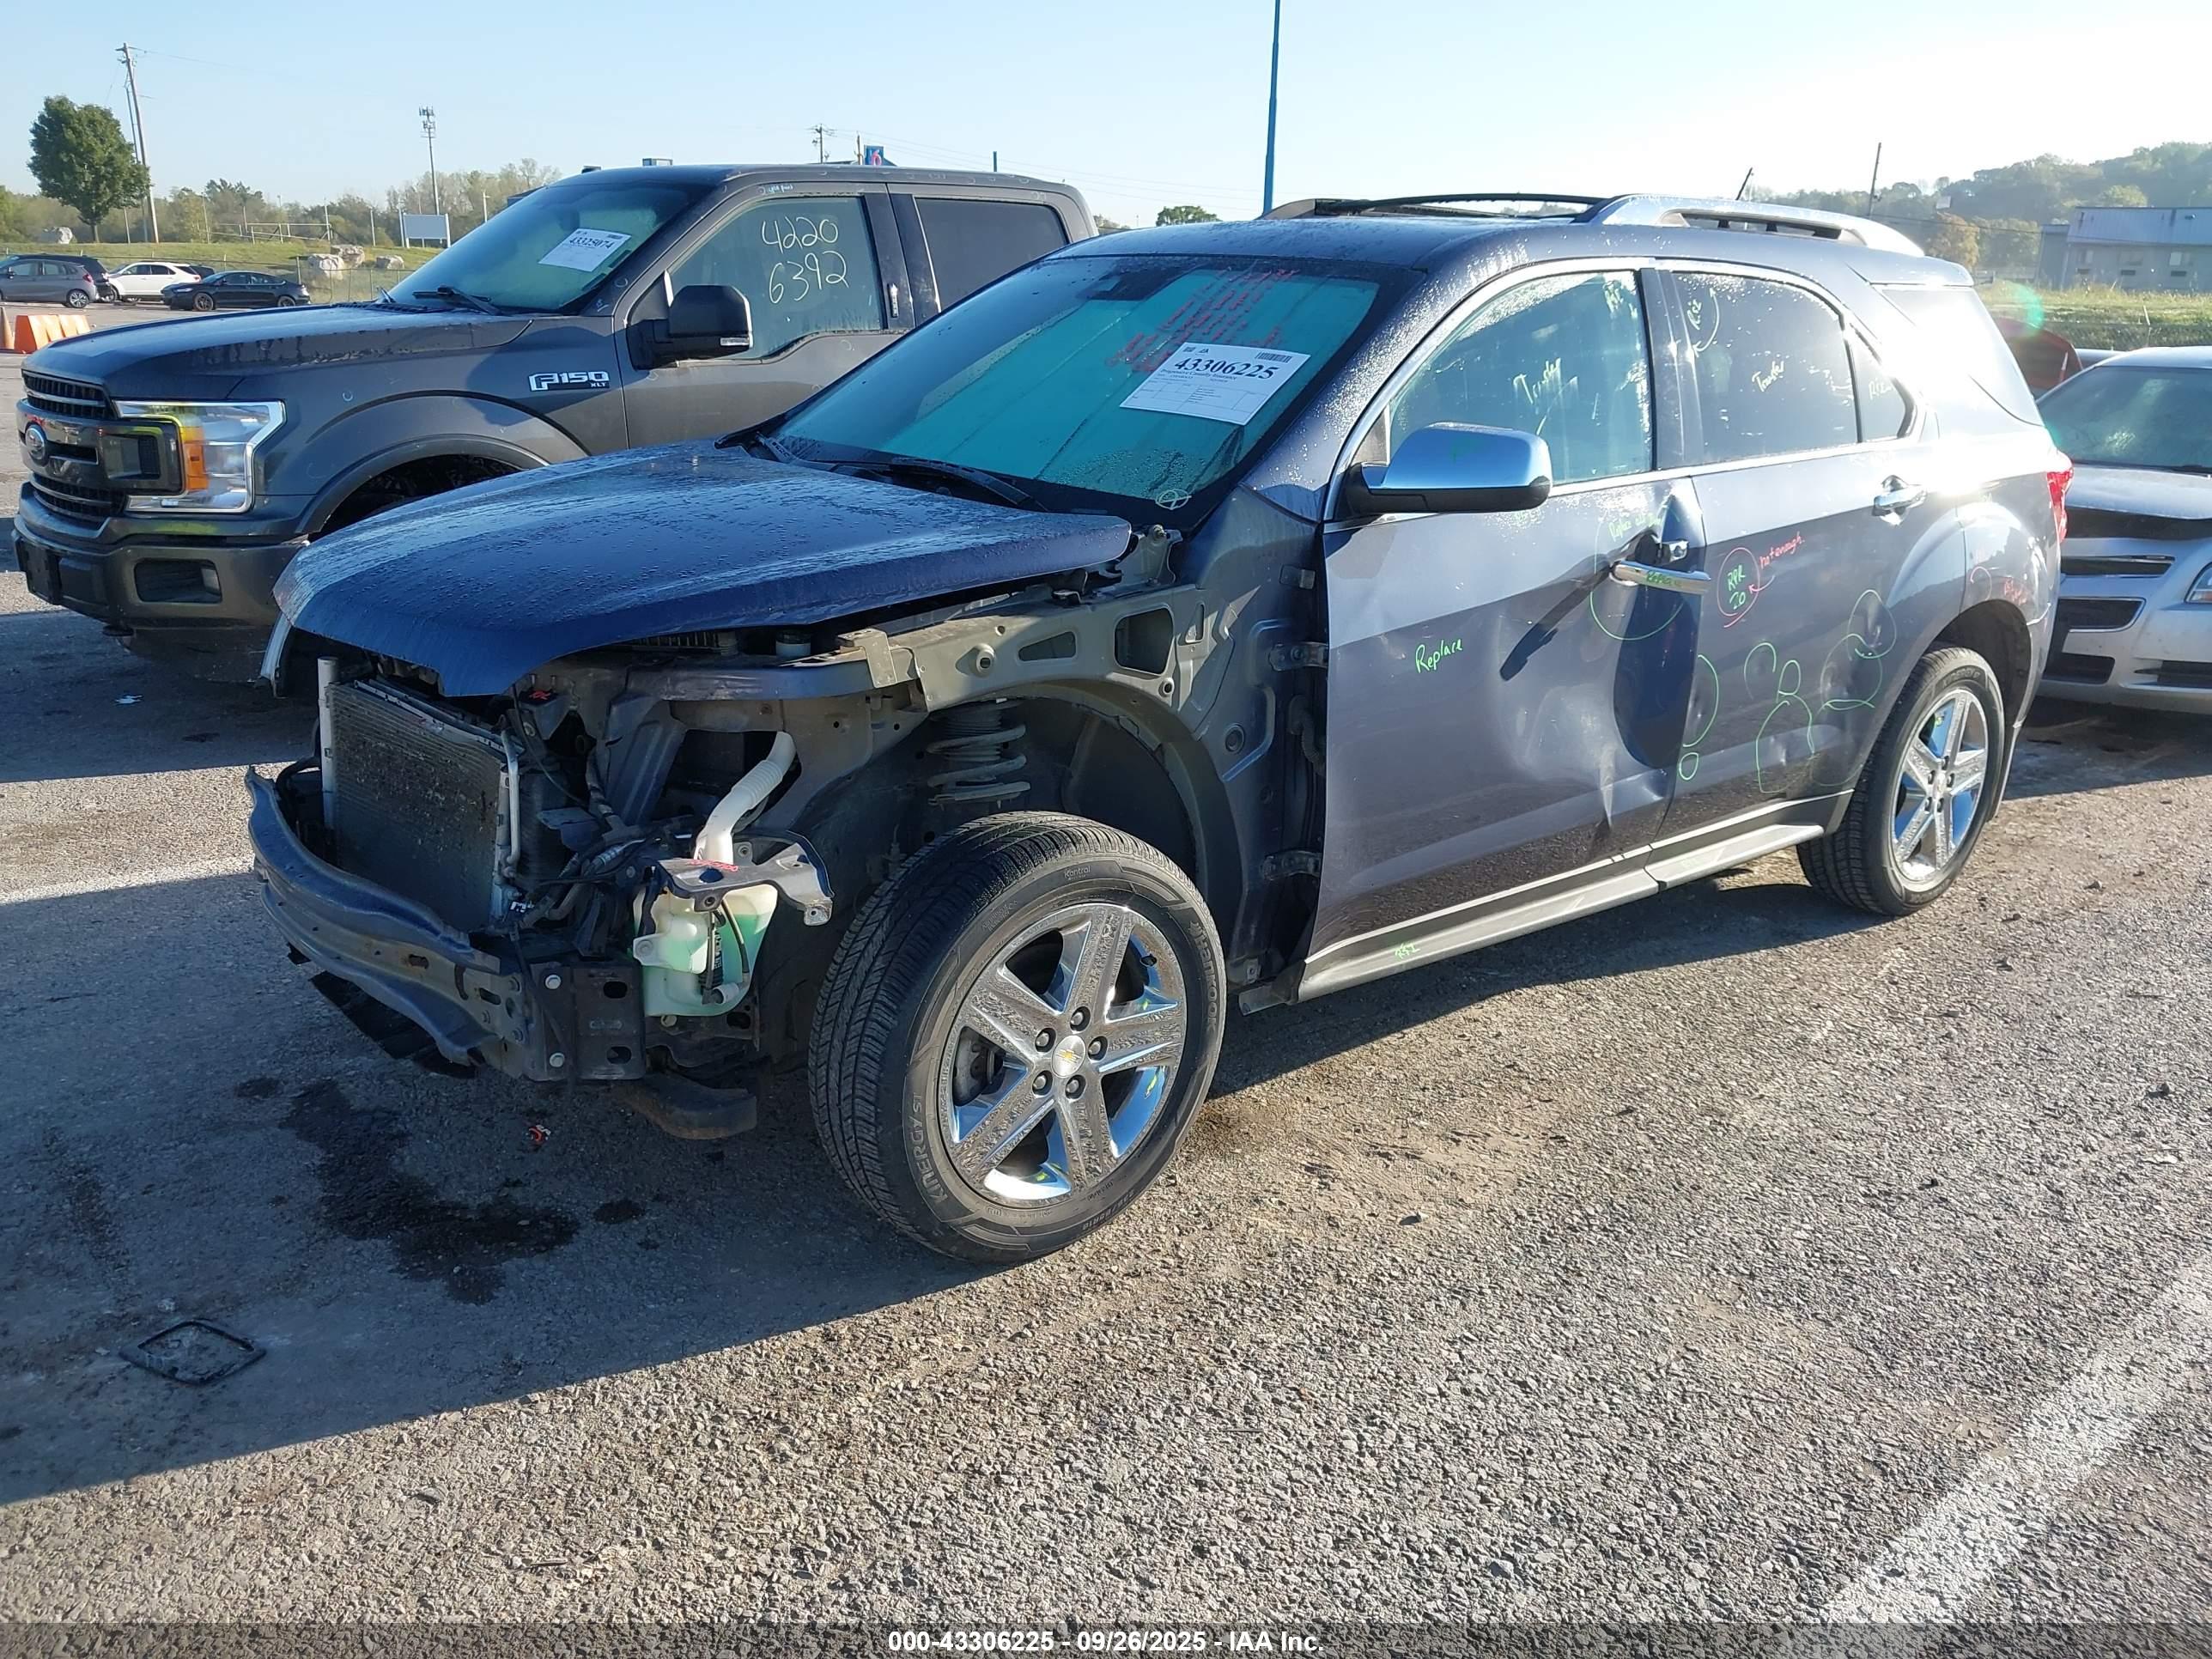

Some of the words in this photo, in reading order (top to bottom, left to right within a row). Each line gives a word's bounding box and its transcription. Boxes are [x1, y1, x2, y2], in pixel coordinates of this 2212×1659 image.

[761, 216, 839, 254] 4220
[769, 250, 849, 304] 6392
[1174, 357, 1279, 380] 43306225
[1415, 638, 1464, 674] Replace
